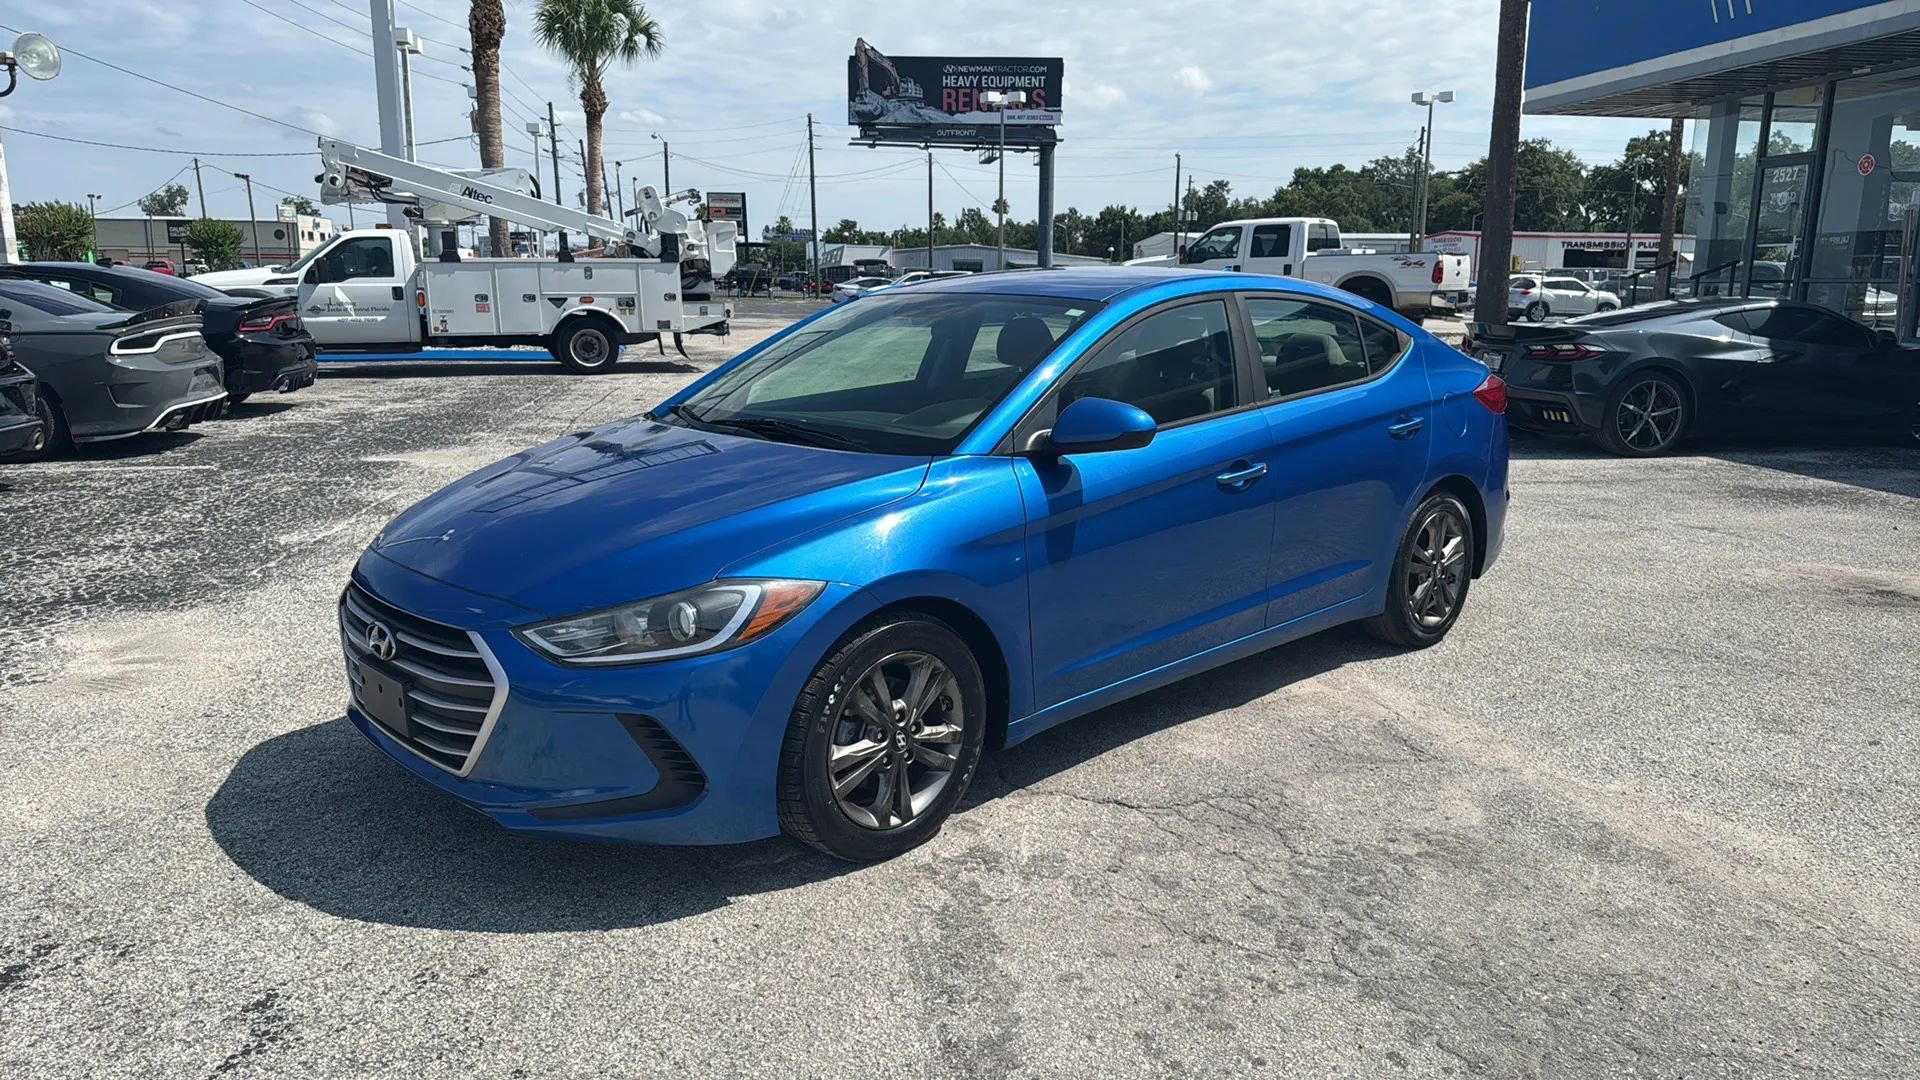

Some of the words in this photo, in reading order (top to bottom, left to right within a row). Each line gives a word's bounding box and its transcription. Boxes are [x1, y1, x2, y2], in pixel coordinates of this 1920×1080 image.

[958, 65, 1048, 73] NEWMANTRACTOR.COM
[942, 75, 980, 88] HEAVY
[981, 76, 1047, 88] EQUIPMENT
[943, 88, 1046, 112] RENS
[1772, 167, 1799, 184] 2527
[461, 186, 493, 204] Altec
